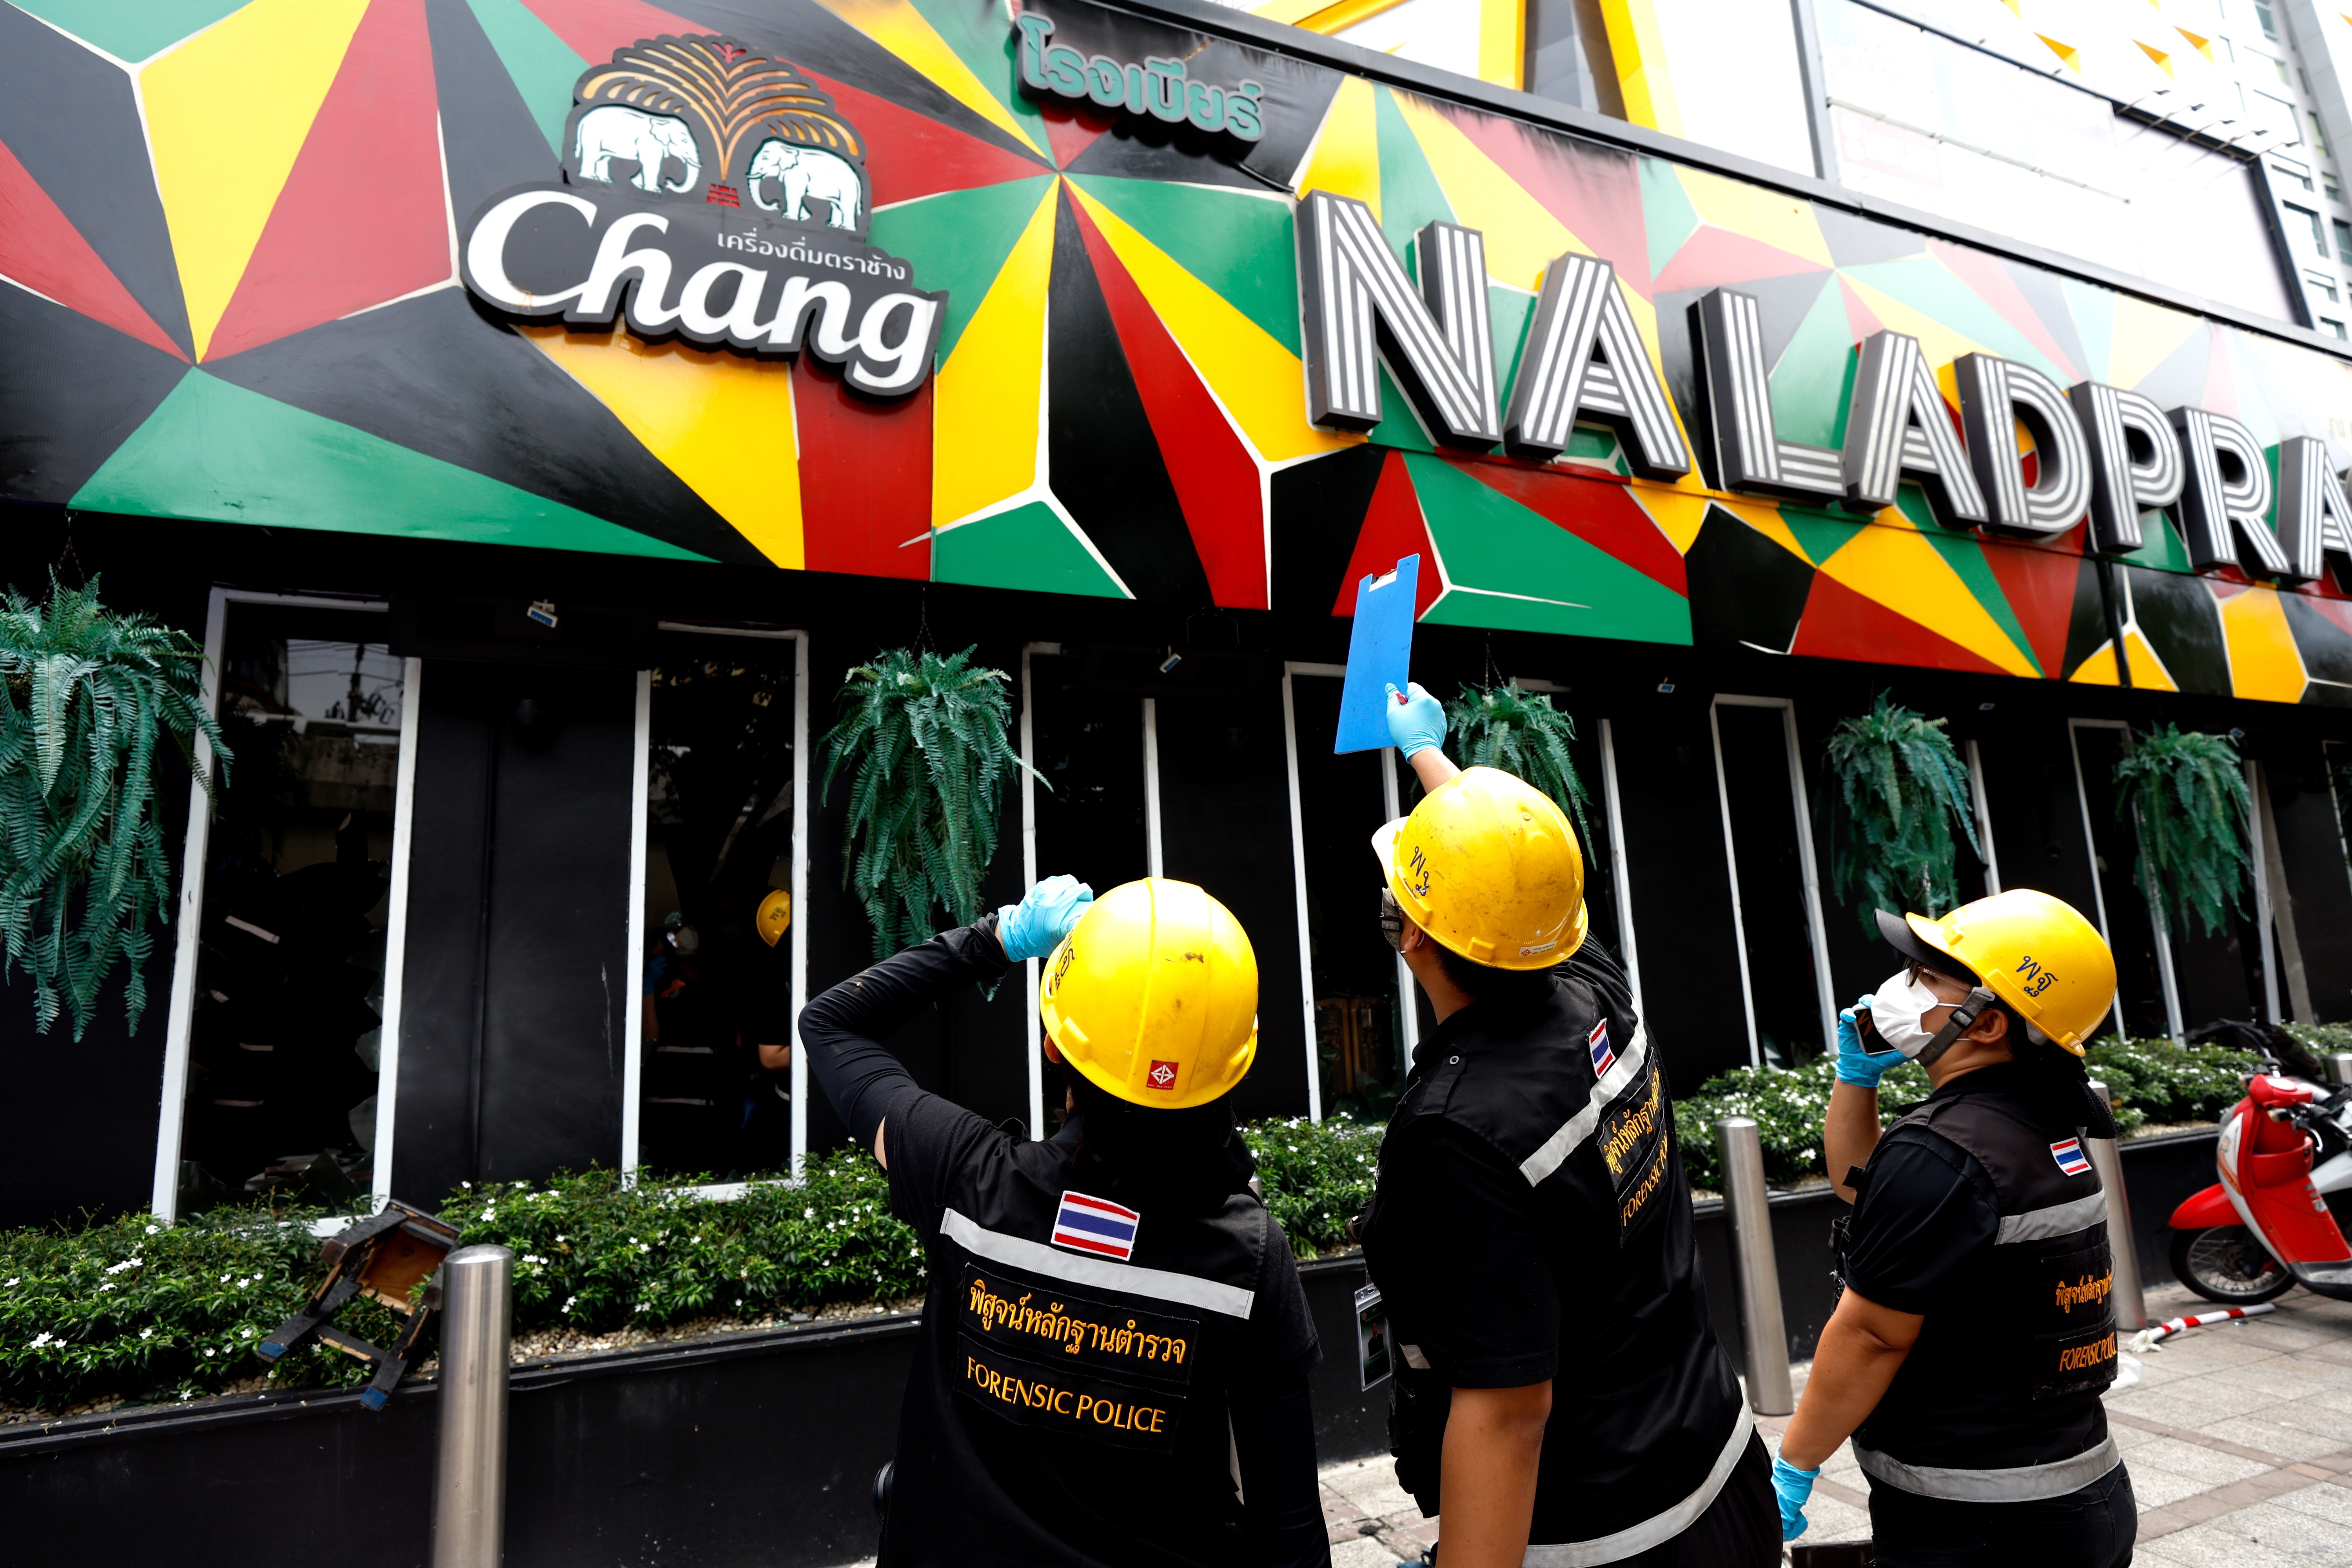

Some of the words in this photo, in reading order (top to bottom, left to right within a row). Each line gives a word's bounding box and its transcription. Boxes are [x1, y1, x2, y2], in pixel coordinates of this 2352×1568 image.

[1018, 12, 1263, 139] โรงเบียร์
[466, 189, 941, 390] Chang
[717, 227, 906, 280] เครื่องดื่มตราช้าง
[1311, 191, 1690, 481] NA
[1703, 287, 2352, 585] LADPRA
[1622, 1157, 1662, 1227] FORENSIC
[969, 1279, 1186, 1364] พิสูจน์หลักฐานตำรวจ
[2059, 1340, 2101, 1372] FORENSIC
[967, 1356, 1073, 1414] FORENSIC
[1076, 1394, 1166, 1433] POLICE
